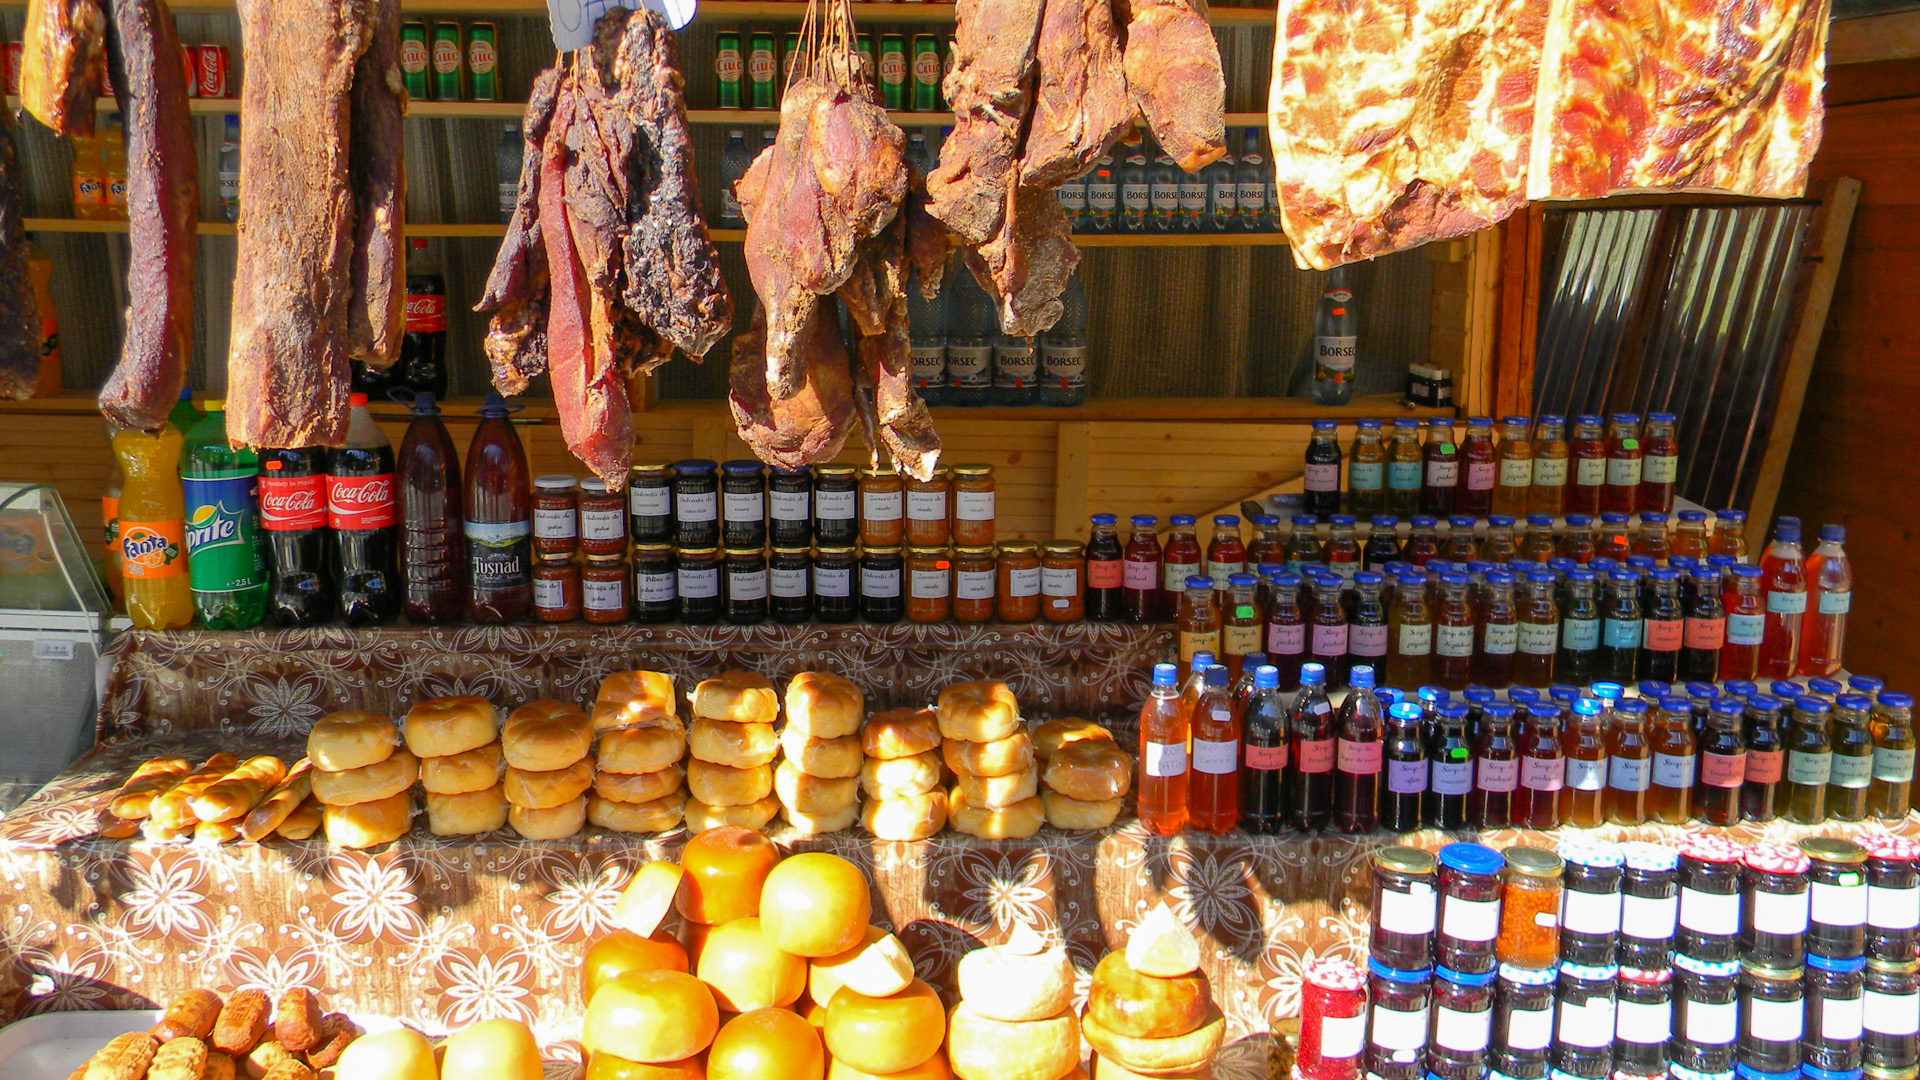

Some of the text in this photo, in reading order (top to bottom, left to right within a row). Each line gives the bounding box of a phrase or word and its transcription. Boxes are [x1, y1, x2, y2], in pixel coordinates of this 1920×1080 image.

[401, 50, 428, 63] Ciuc
[434, 50, 459, 63] Ciuc
[469, 50, 495, 63] Ciuc
[716, 60, 743, 72] Ciuc
[750, 60, 775, 72] Ciuc
[880, 61, 907, 73] Ciuc
[915, 61, 941, 73] Ciuc
[1061, 190, 1085, 199] BORSE
[1154, 190, 1178, 199] BORSE
[912, 357, 941, 366] ORSEC
[950, 357, 976, 366] ORSEC
[1000, 355, 1036, 366] BORSEC
[1047, 355, 1082, 366] BORSEC
[331, 480, 390, 504] Coca-Cola
[263, 490, 317, 511] Coca-Cola
[123, 534, 167, 561] Fanta
